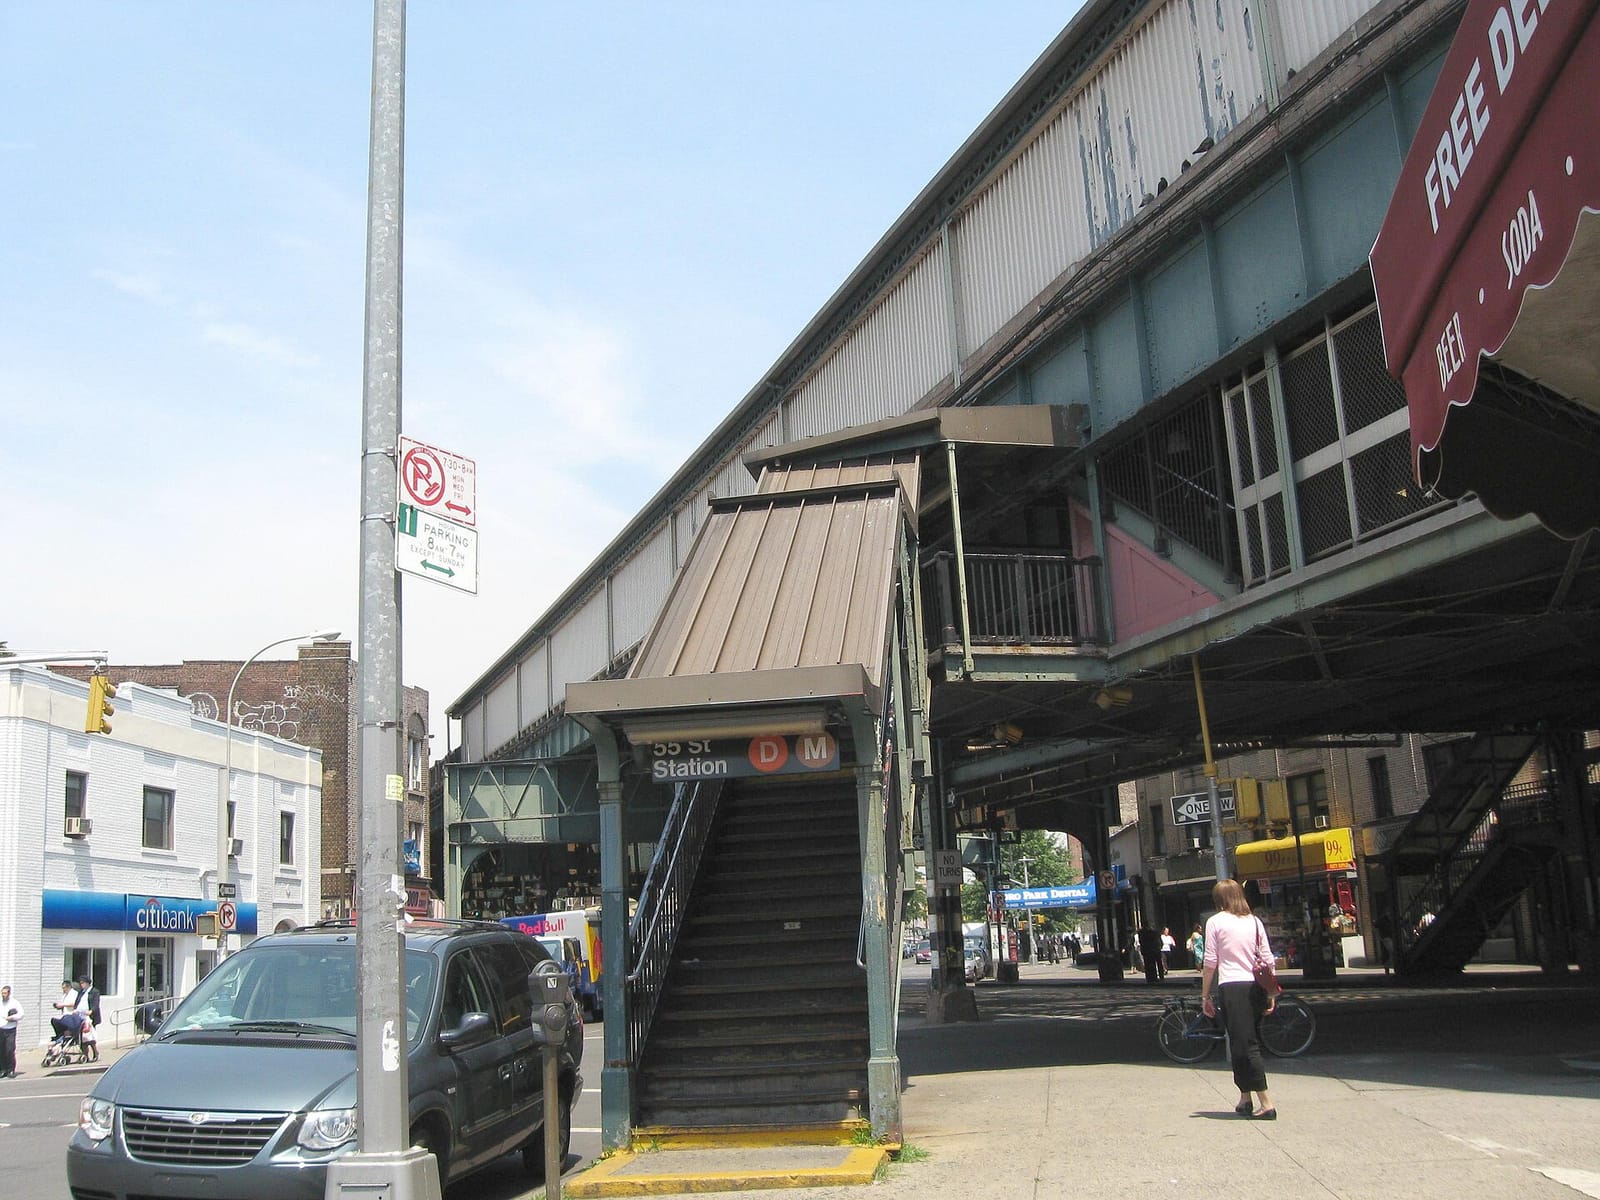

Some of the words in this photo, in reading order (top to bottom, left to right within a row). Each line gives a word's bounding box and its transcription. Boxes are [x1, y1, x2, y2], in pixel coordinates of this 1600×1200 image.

[1424, 57, 1490, 235] FREE
[1487, 0, 1550, 96] DE
[1502, 190, 1544, 290] SODA
[1435, 311, 1466, 393] BEER
[423, 523, 469, 548] PARKING
[760, 741, 779, 763] D
[803, 737, 828, 761] M
[653, 758, 728, 778] Station
[1185, 801, 1210, 814] ONE
[938, 866, 961, 877] TURNS
[943, 855, 955, 865] NO
[136, 903, 194, 930] citibank
[518, 920, 544, 935] Red
[543, 918, 565, 932] Bull
